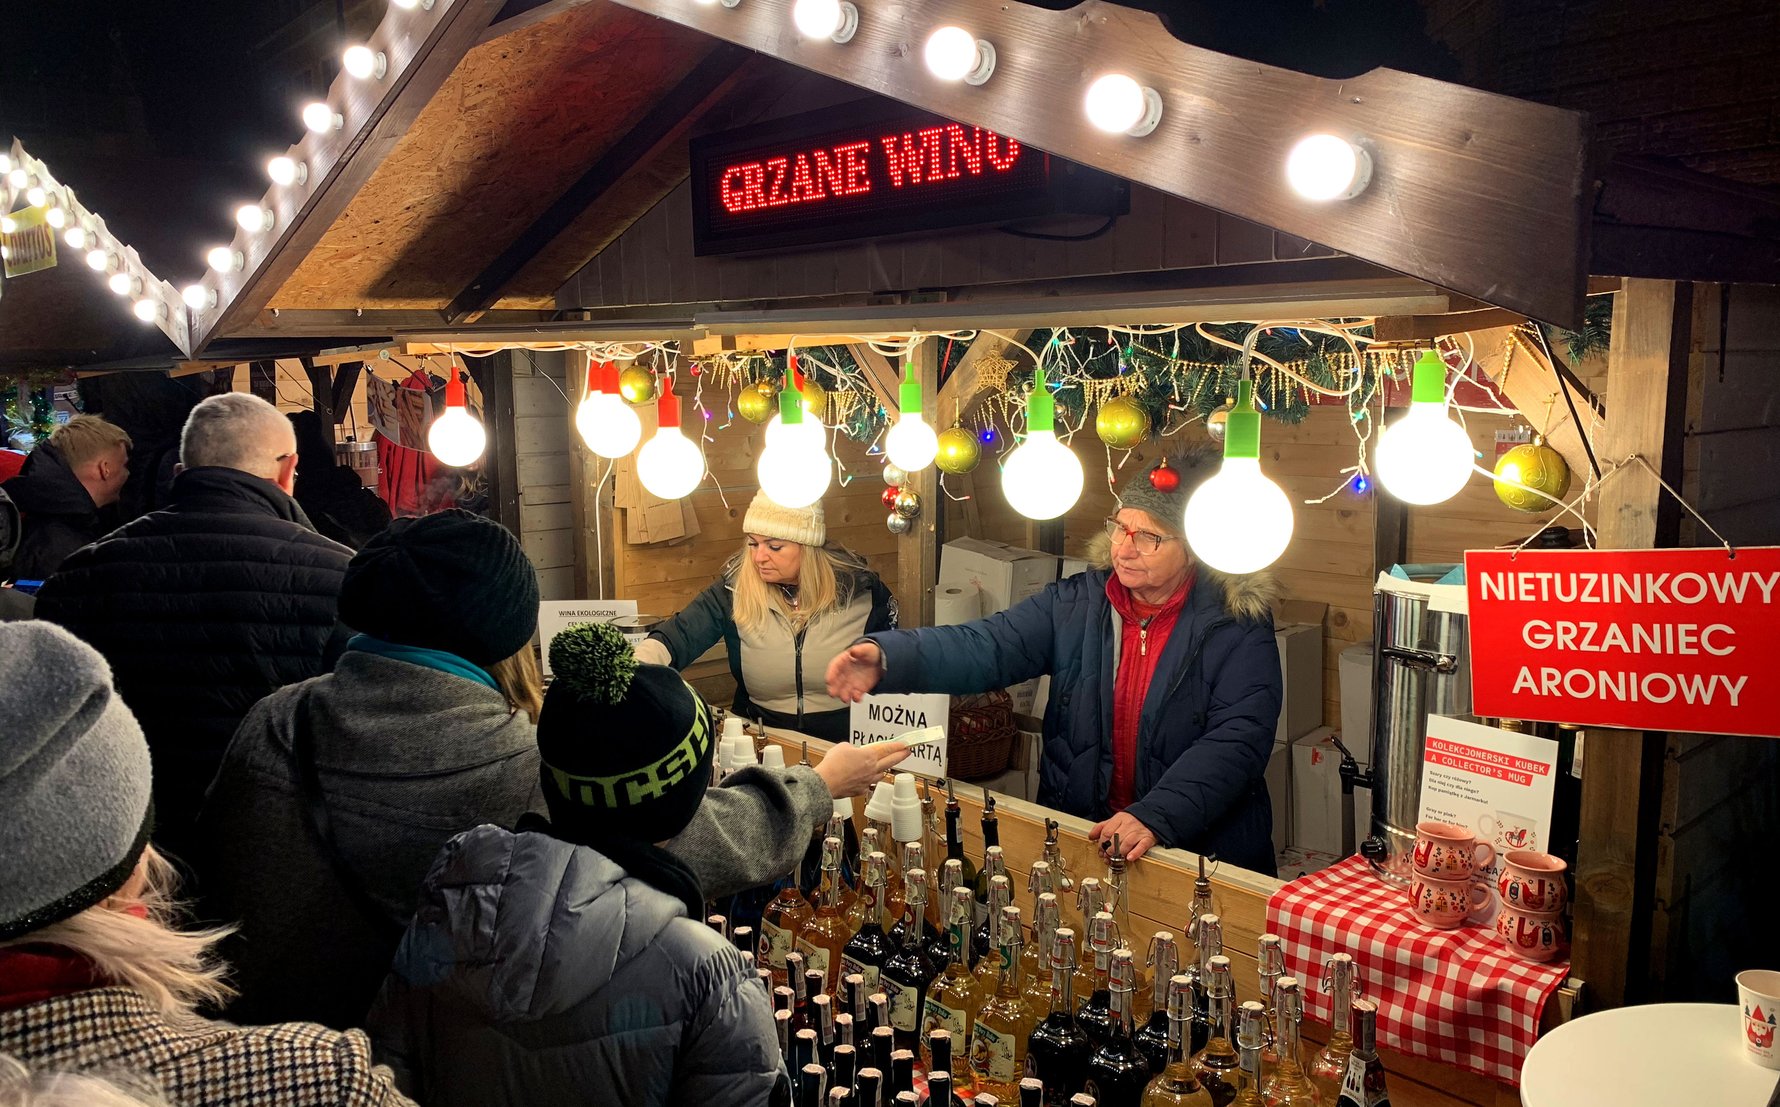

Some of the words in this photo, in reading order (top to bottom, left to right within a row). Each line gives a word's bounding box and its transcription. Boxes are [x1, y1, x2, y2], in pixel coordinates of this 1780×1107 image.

[721, 142, 870, 212] GRZANE
[1480, 571, 1780, 604] NIETUZINKOWY
[1522, 619, 1736, 656] GRZANIEC
[1512, 666, 1749, 707] ARONIOWY
[869, 704, 927, 728] MOŻNA
[909, 743, 942, 767] ARTĄ
[1432, 740, 1509, 766] KOLEKCJONERSKI
[1515, 759, 1545, 774] KUBEK
[1441, 756, 1503, 778] COLLECTOR'S
[1508, 772, 1526, 784] MUG
